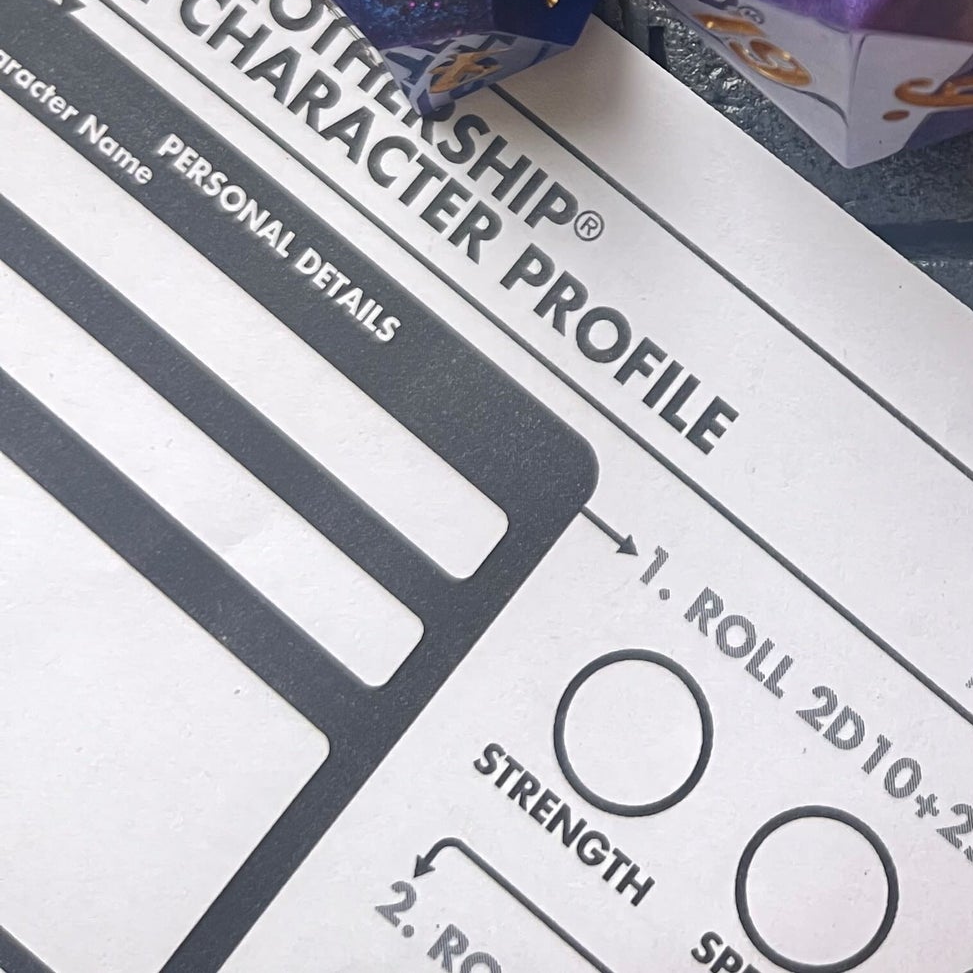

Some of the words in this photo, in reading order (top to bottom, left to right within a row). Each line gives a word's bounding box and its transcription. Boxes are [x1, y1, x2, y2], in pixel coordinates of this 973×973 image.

[77, 114, 154, 185] Name
[157, 134, 296, 258] PERSONAL
[295, 248, 401, 344] DETAILS
[500, 243, 739, 455] PROFILE
[639, 545, 671, 601] 1.
[684, 587, 794, 698] ROLL
[472, 742, 655, 908] STRENGTH
[374, 880, 416, 938] 2.
[690, 931, 763, 973] SP
